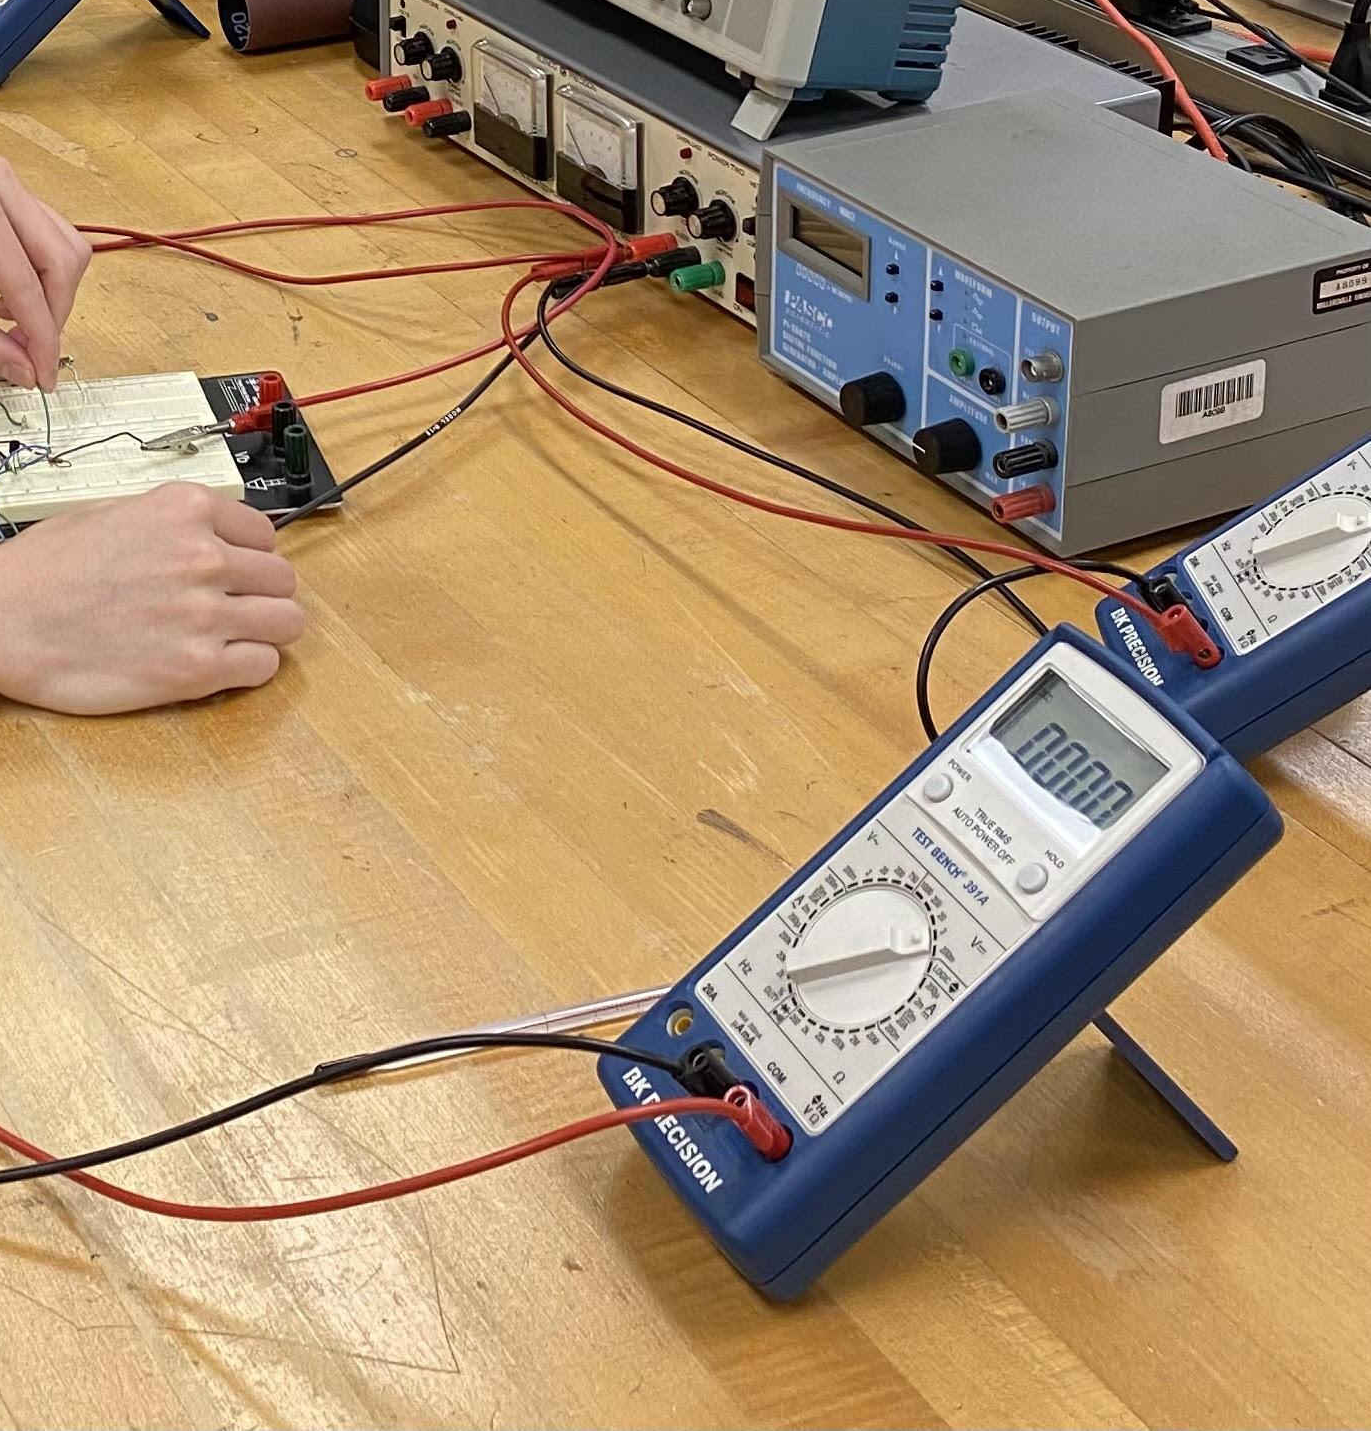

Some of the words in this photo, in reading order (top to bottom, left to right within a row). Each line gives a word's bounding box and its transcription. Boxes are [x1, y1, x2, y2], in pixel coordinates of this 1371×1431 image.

[1110, 606, 1130, 628] BK
[1120, 620, 1165, 687] PRECISION
[947, 758, 973, 783] POWER
[951, 805, 975, 829] AUTO
[970, 823, 1000, 853] POWER
[996, 847, 1017, 867] OFF
[974, 807, 999, 830] TRUE
[993, 825, 1013, 846] RMS
[911, 826, 933, 850] TEST
[962, 879, 990, 907] 391A
[1044, 849, 1065, 870] HOLD
[738, 958, 753, 976] Hz
[932, 963, 952, 985] LOGIC
[702, 982, 718, 1002] 20A
[767, 1061, 788, 1086] COM
[832, 1070, 846, 1084] Ω
[622, 1066, 652, 1100] BK
[641, 1091, 724, 1194] PECISION
